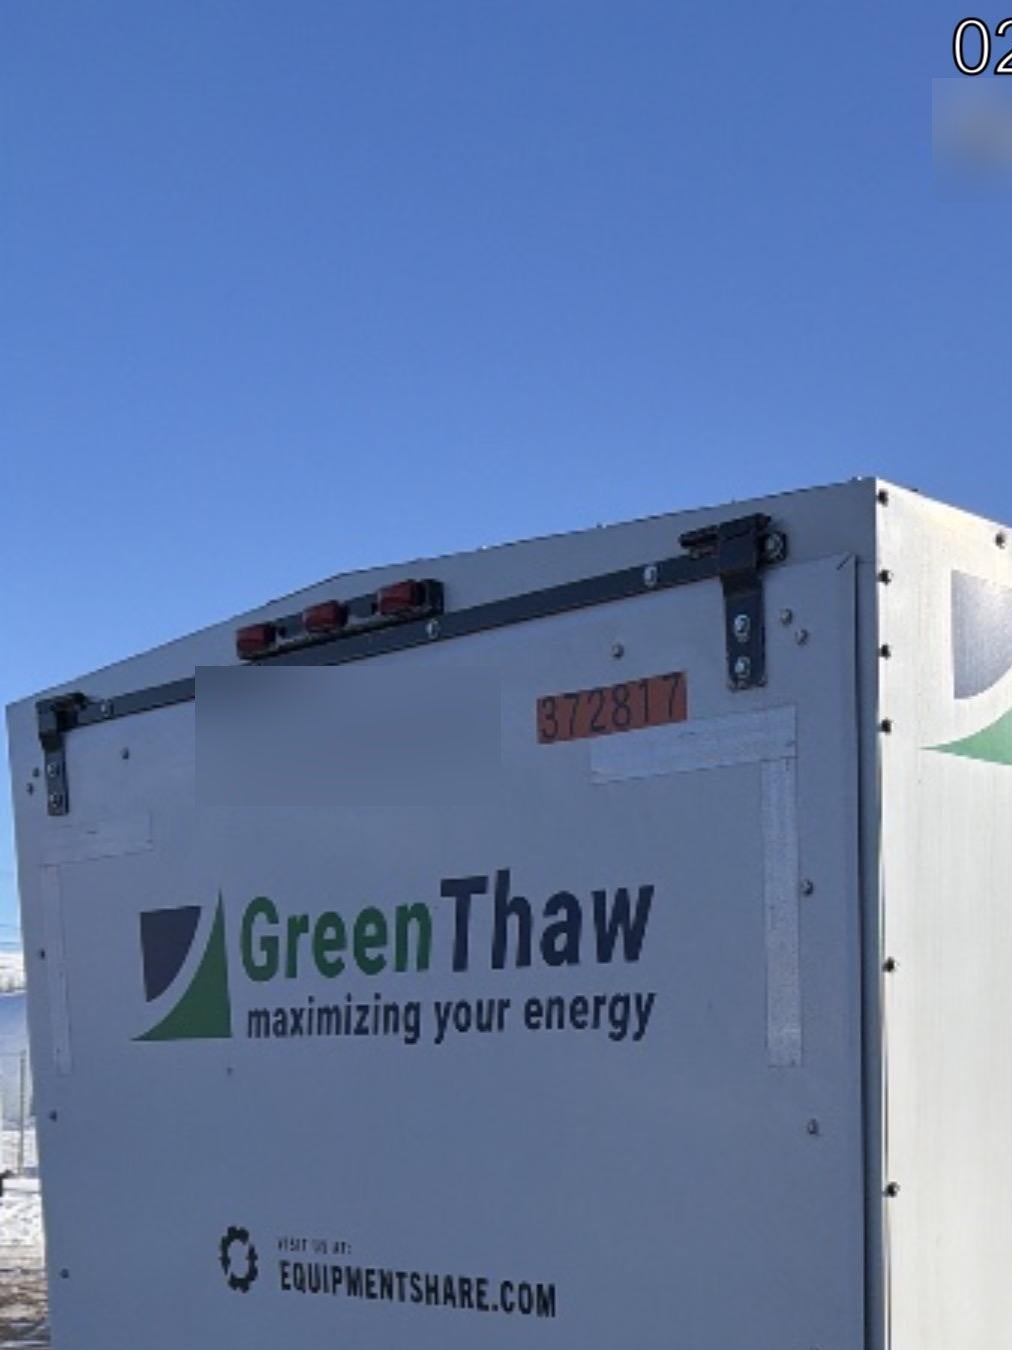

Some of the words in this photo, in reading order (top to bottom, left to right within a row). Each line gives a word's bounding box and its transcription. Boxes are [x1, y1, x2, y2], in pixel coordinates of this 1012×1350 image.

[541, 672, 684, 739] 372817
[247, 993, 421, 1045] maximizing
[433, 997, 511, 1045] your
[523, 991, 657, 1042] energy
[279, 1259, 557, 1318] EQUIPMENTSHARE.COM
